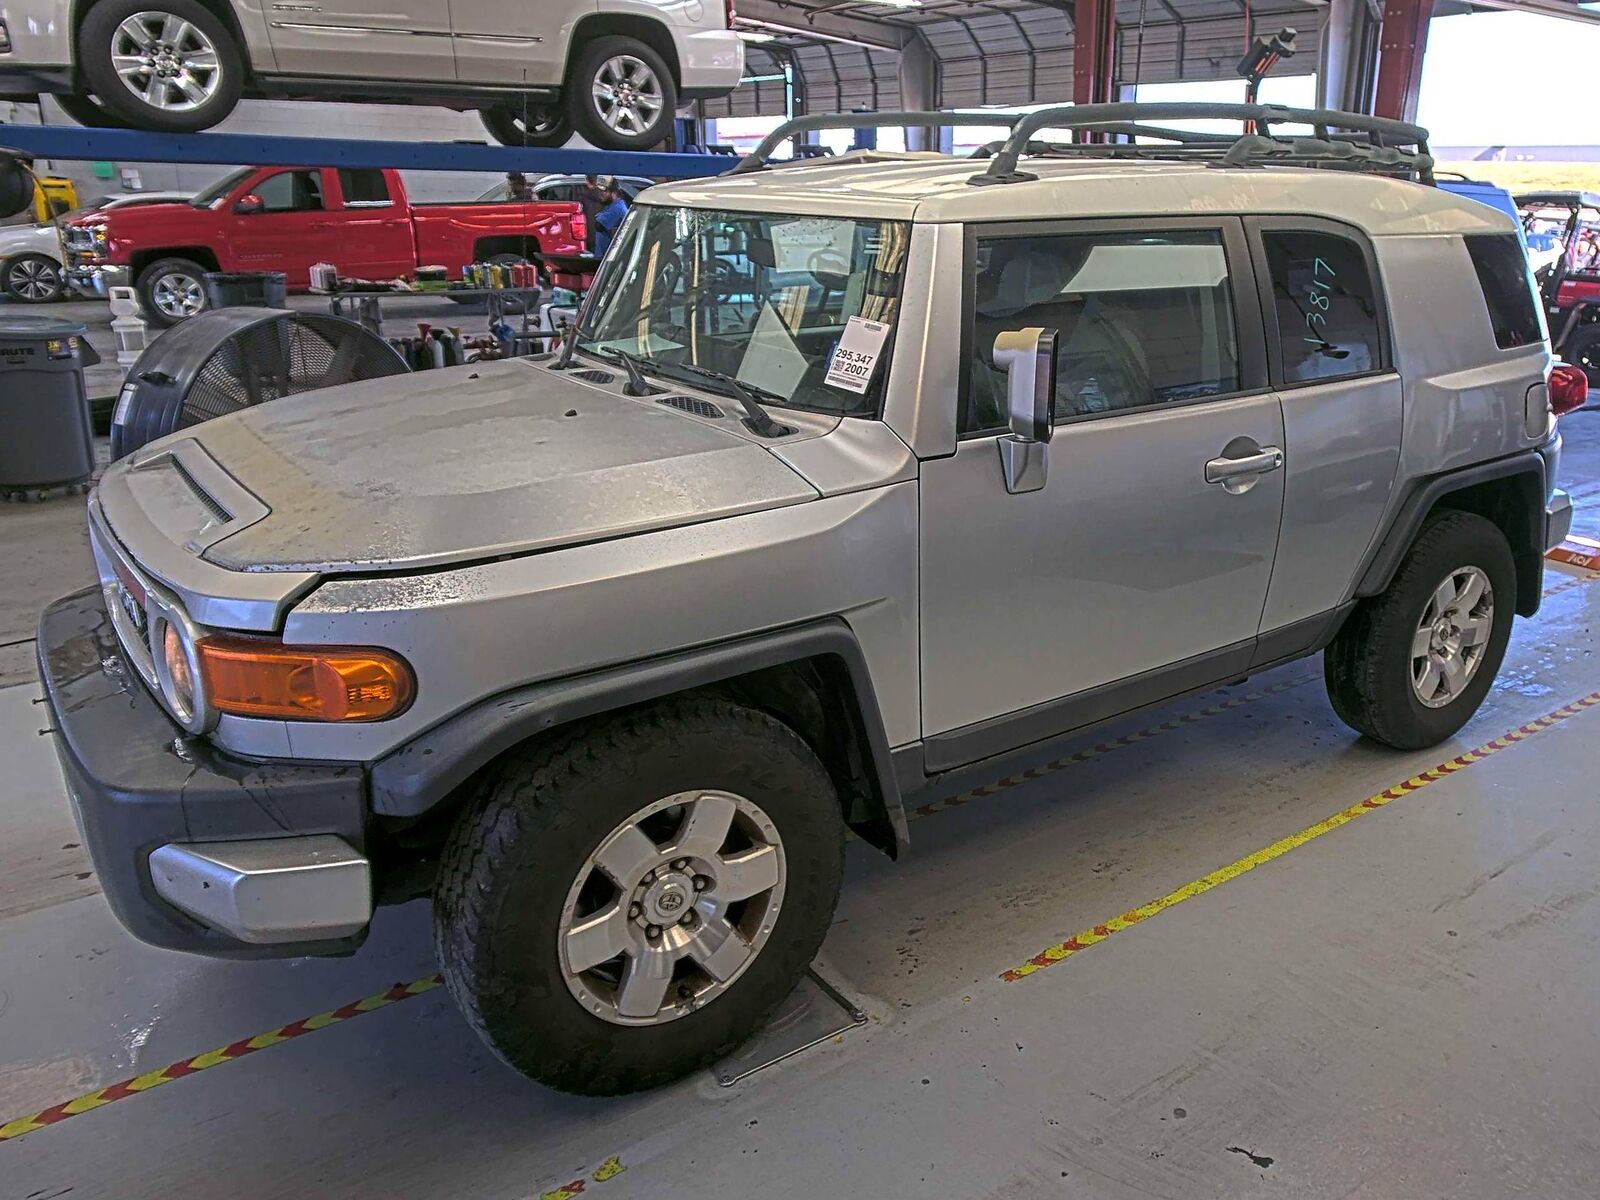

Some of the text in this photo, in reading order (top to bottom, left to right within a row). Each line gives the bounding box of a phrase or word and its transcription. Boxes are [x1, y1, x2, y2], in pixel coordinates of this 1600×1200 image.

[1303, 257, 1336, 344] 13817
[835, 348, 873, 365] 295,347
[844, 363, 869, 377] 2007
